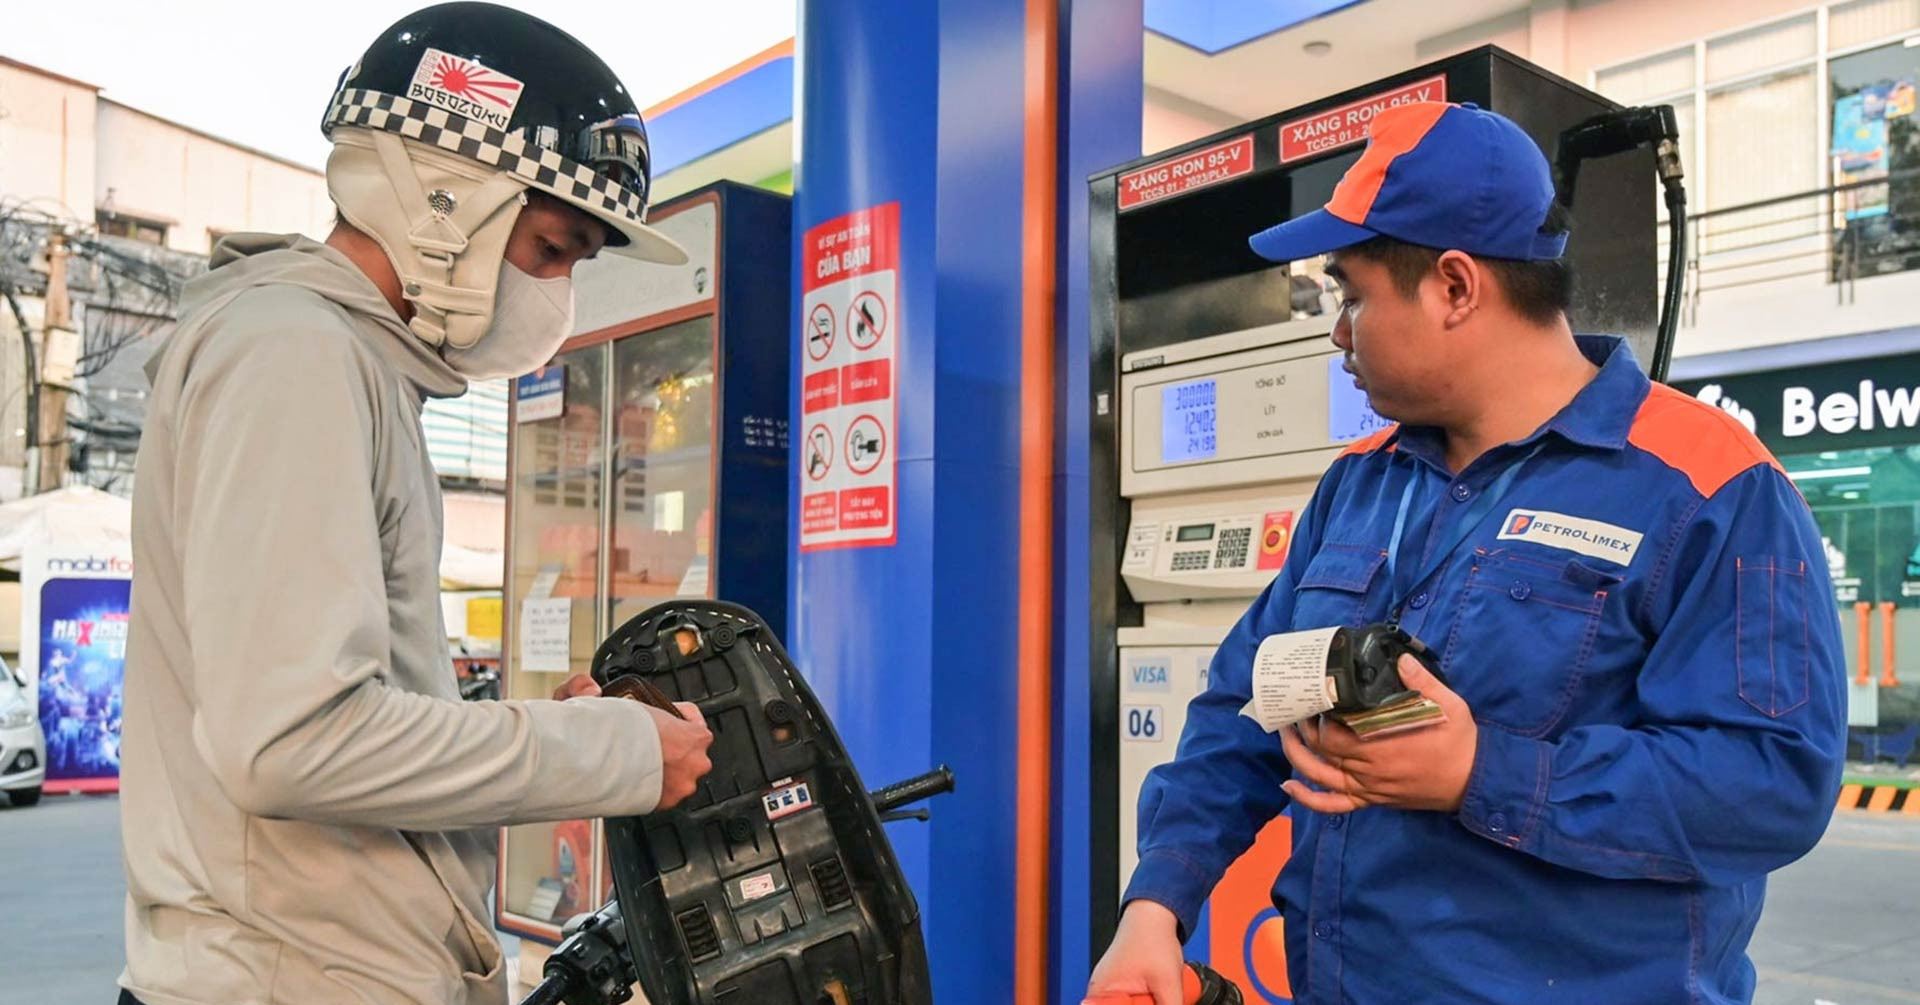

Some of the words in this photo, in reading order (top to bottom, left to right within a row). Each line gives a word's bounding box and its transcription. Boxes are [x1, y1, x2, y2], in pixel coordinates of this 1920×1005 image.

[411, 83, 509, 129] BOSOZOKU
[1292, 116, 1341, 143] XĂNG
[1306, 135, 1337, 152] TCCS
[1339, 131, 1351, 143] 01
[1128, 168, 1169, 192] XĂNG
[1172, 157, 1205, 179] RON
[1207, 145, 1241, 168] 95-V
[1139, 185, 1165, 201] TCCS
[1166, 182, 1178, 194] 01
[817, 250, 840, 279] CỦA
[842, 245, 871, 272] BẠN
[1176, 381, 1216, 411] 300000
[1532, 521, 1632, 553] PETROLIMEX
[1132, 666, 1167, 683] VISA
[1129, 709, 1156, 737] 06
